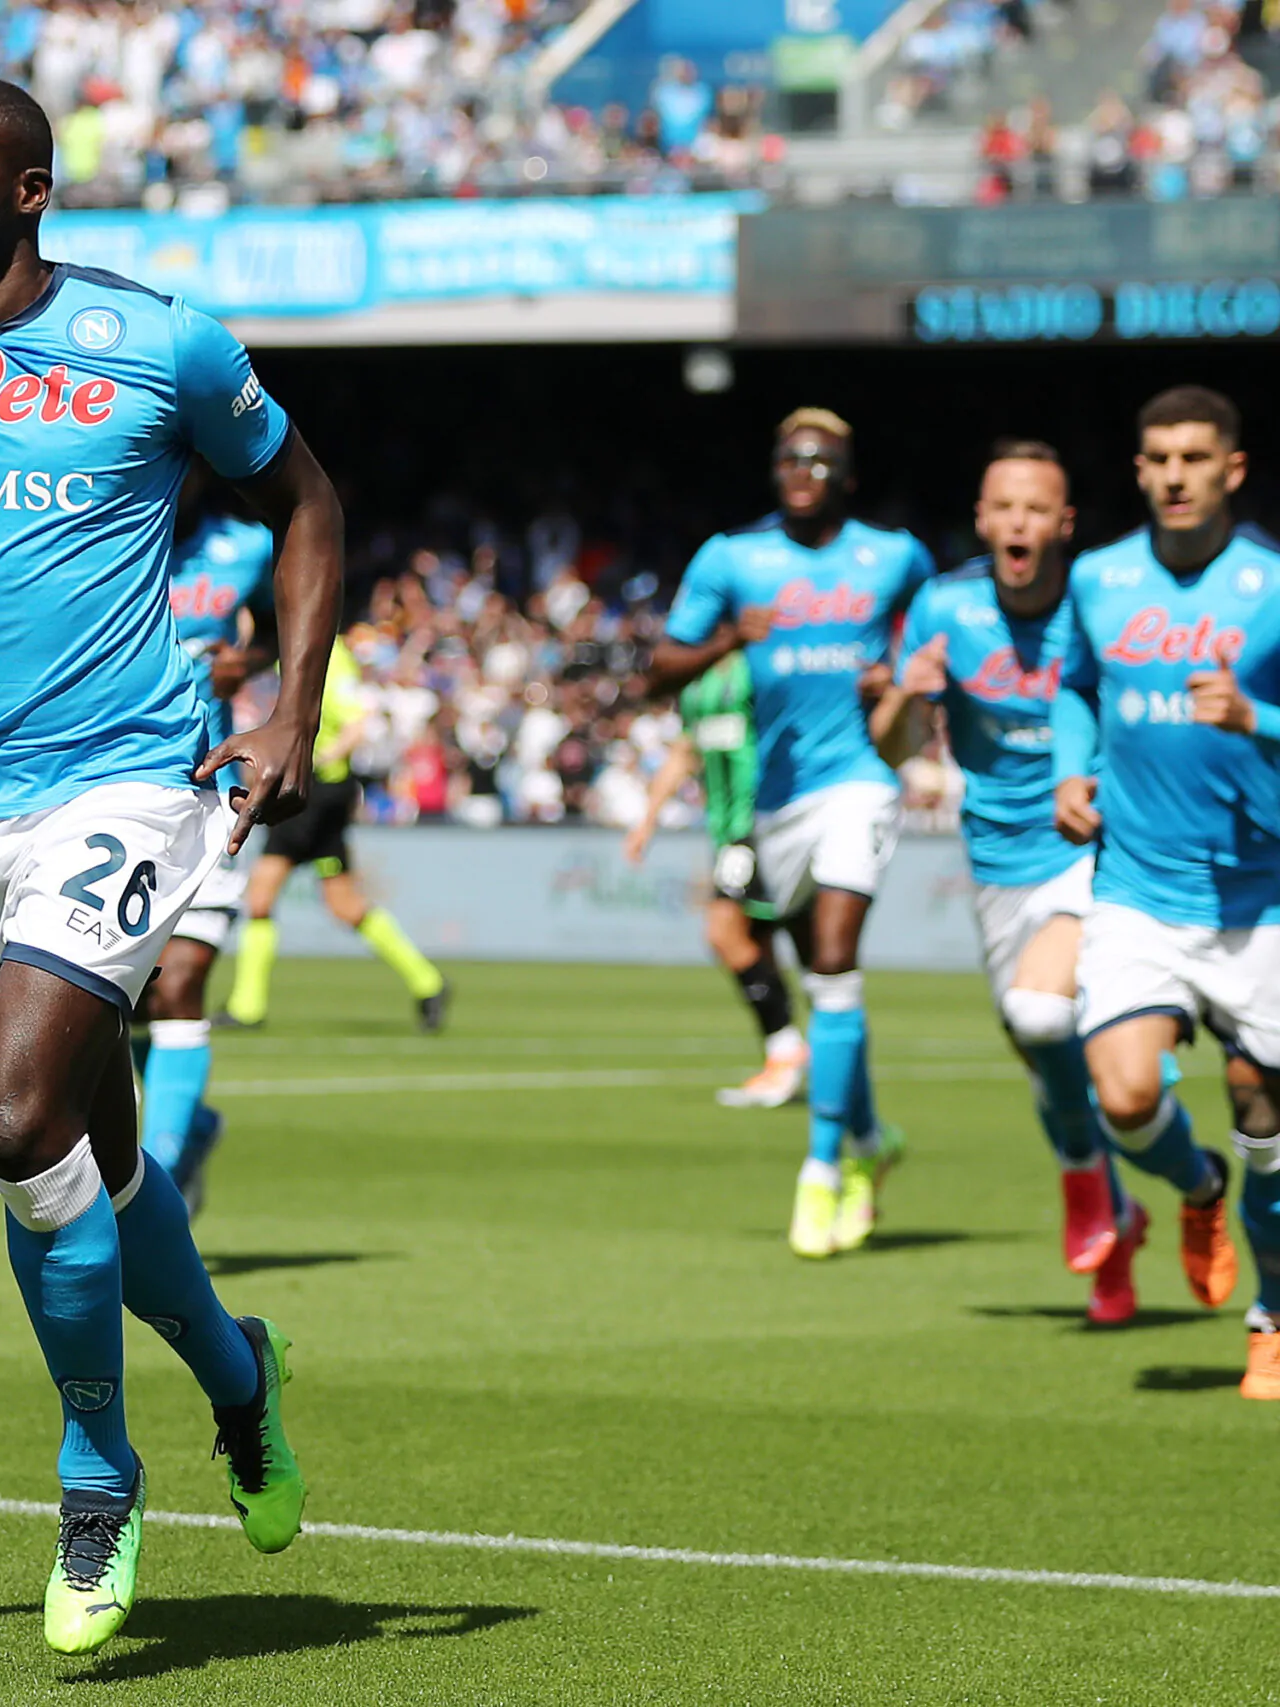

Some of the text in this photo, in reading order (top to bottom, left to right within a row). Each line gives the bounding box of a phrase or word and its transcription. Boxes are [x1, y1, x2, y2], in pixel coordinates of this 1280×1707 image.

[82, 317, 110, 342] N
[915, 276, 1280, 342] STADIO DIEGO
[169, 572, 239, 620] ete
[1102, 605, 1246, 667] Lete
[961, 645, 1063, 703] Let
[60, 833, 157, 937] 26
[66, 907, 123, 951] EA7
[71, 1386, 101, 1403] N
